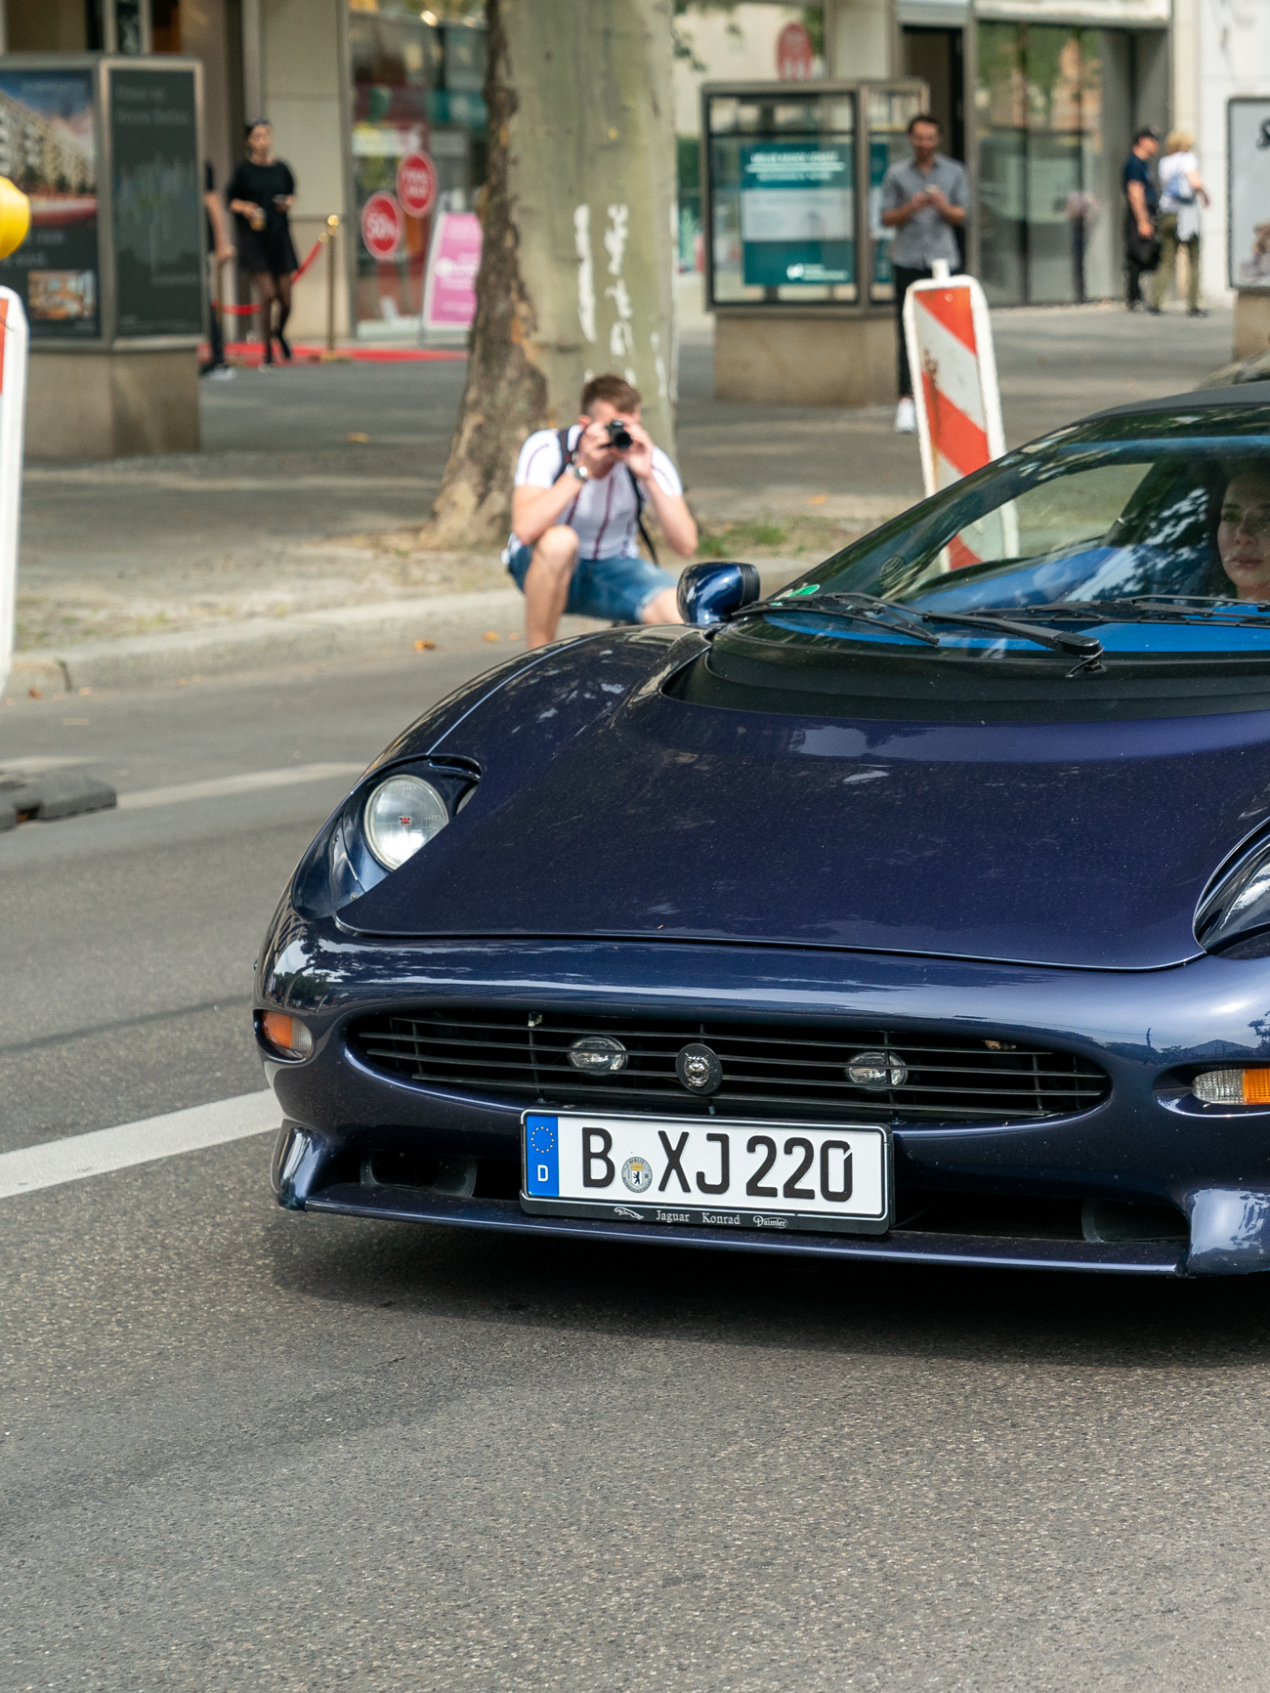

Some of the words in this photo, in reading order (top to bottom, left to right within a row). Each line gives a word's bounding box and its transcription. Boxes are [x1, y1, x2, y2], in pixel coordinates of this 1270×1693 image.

[582, 1126, 616, 1188] B
[537, 1164, 549, 1182] D
[656, 1209, 690, 1223] Jaguar
[701, 1212, 741, 1225] Konrad
[752, 1215, 788, 1228] Daimler
